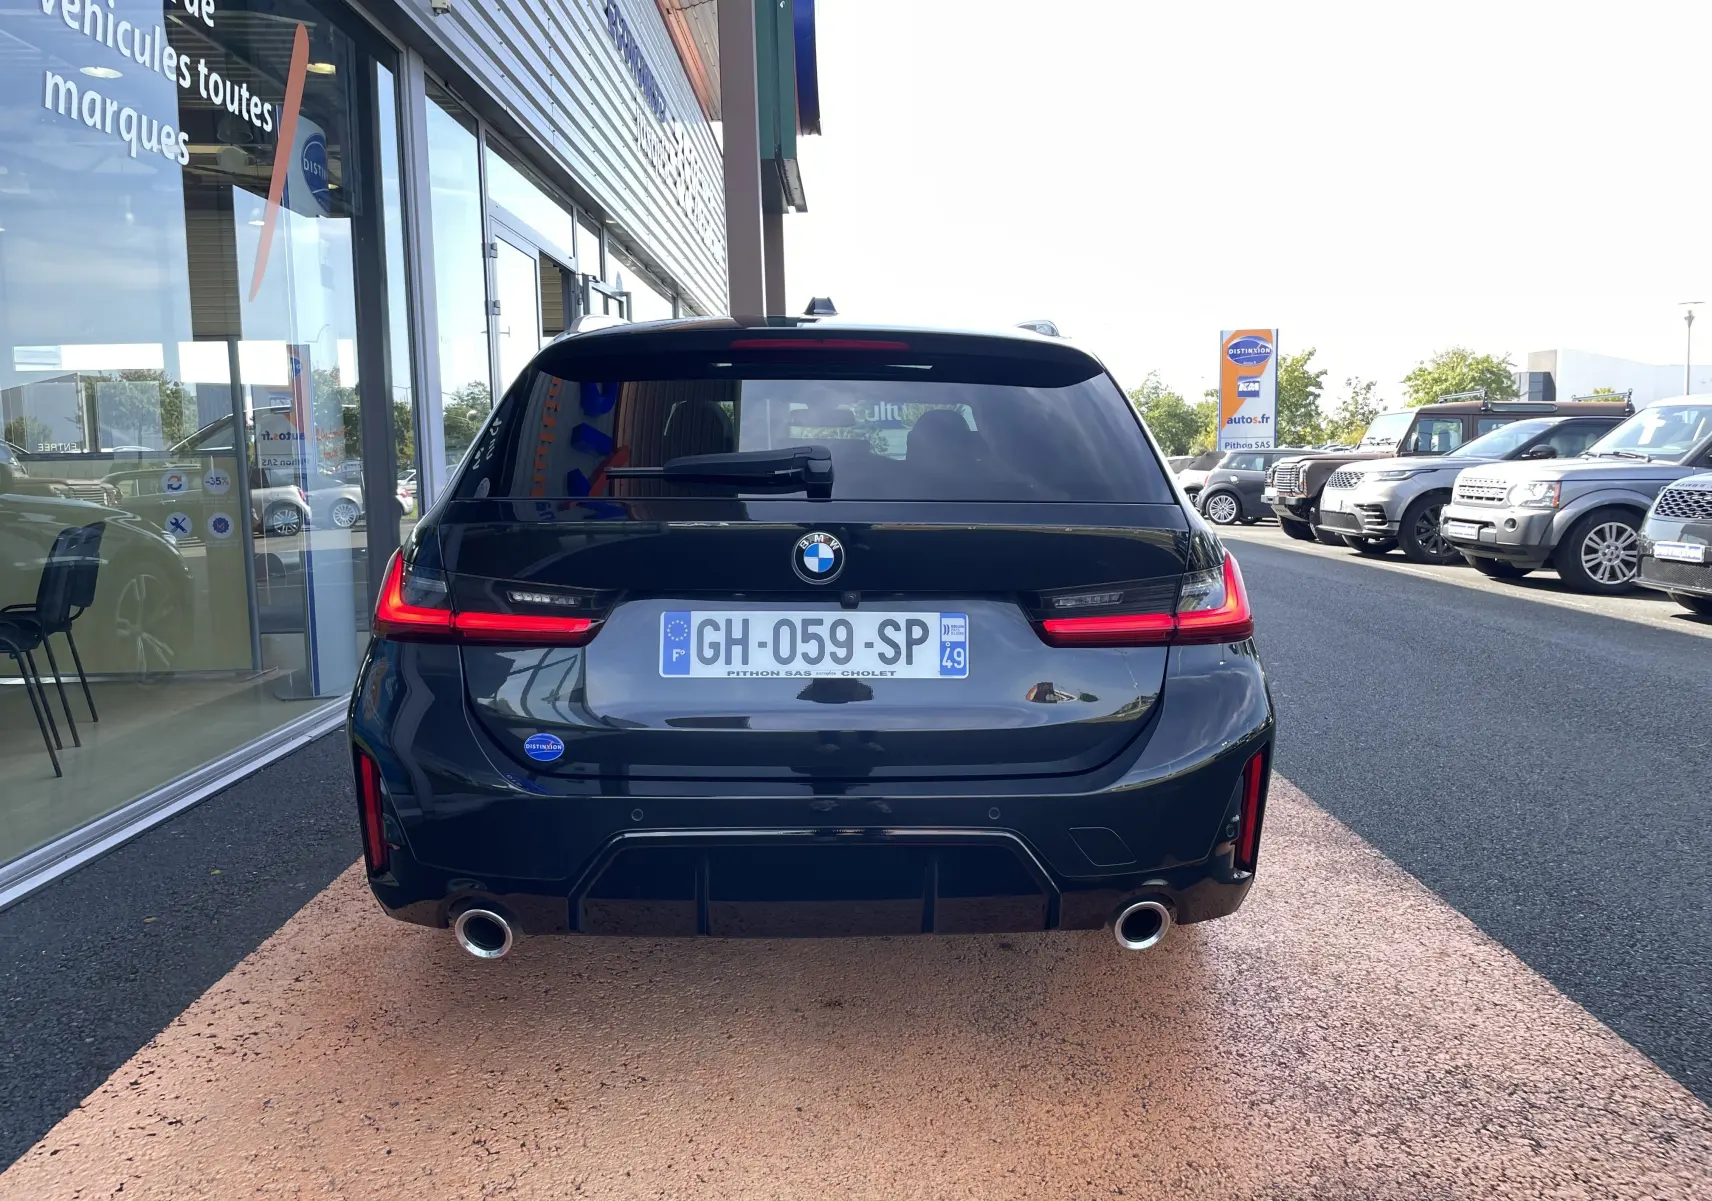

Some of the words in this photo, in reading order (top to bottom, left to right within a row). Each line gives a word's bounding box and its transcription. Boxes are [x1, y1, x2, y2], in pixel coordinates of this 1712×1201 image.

[198, 58, 272, 132] toutes
[45, 70, 189, 165] marques
[1228, 347, 1271, 355] DISTINXION
[1227, 414, 1270, 424] autos.fr
[1255, 441, 1270, 449] SAS
[205, 476, 229, 486] -35%
[799, 534, 839, 550] BMW
[696, 618, 930, 666] GH-059-SP
[673, 649, 680, 662] F
[942, 648, 964, 669] 49
